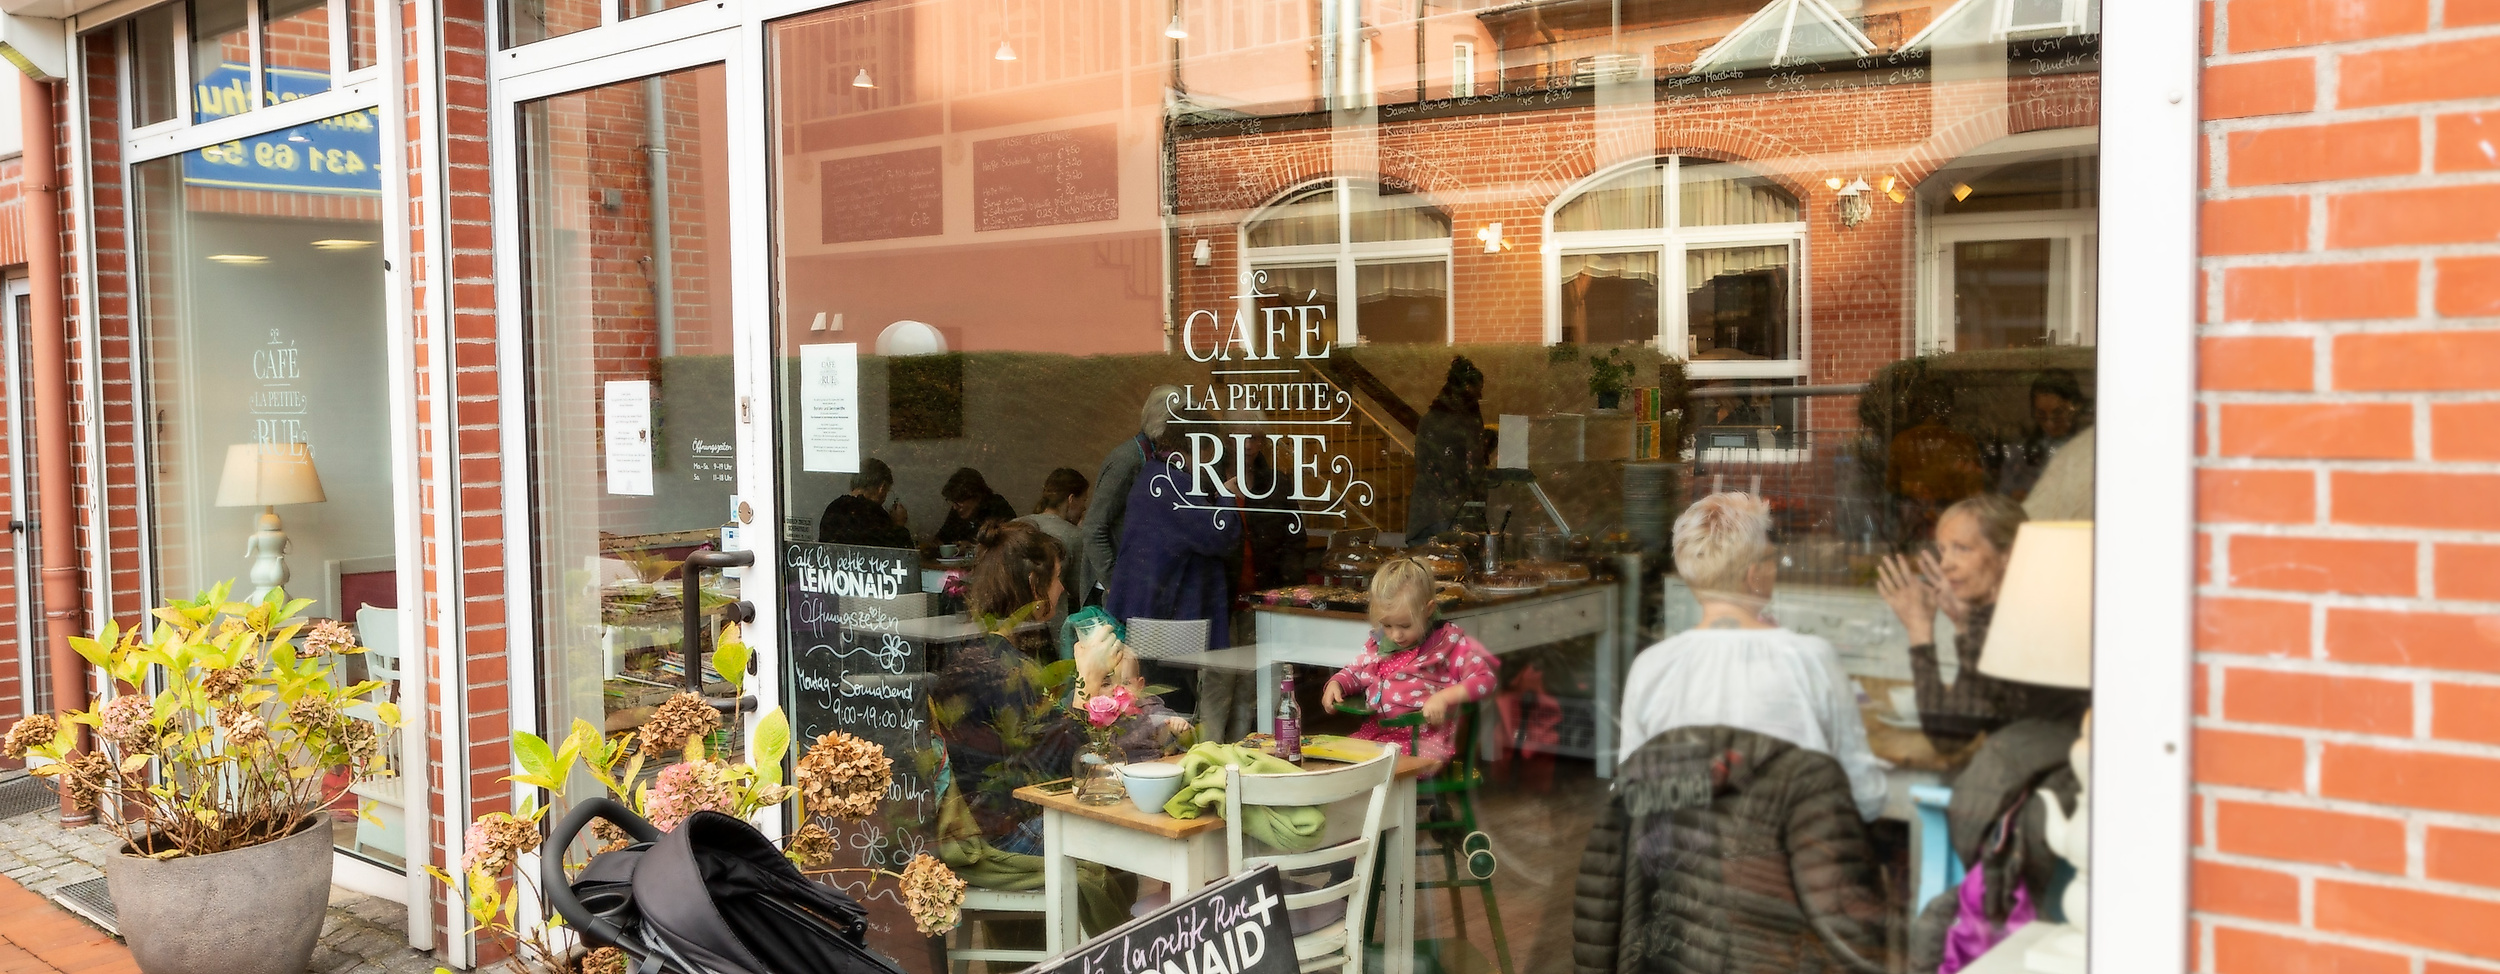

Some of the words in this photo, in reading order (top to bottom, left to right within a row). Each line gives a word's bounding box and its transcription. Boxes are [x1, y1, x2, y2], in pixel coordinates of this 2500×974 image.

[2031, 35, 2066, 53] Wir
[2028, 51, 2088, 75] Demeter
[1667, 74, 1701, 90] Espresso
[1183, 288, 1331, 363] CAFÉ
[253, 339, 300, 379] CAFÉ
[255, 391, 267, 407] LA
[268, 391, 301, 407] PETITE
[1184, 384, 1221, 412] LA
[1227, 383, 1332, 412] PETITE
[256, 418, 303, 457] RUE
[1185, 432, 1332, 502] RUE
[787, 544, 814, 580] Café
[817, 545, 832, 570] la
[900, 708, 924, 753] Uhr
[902, 773, 929, 824] Uhr
